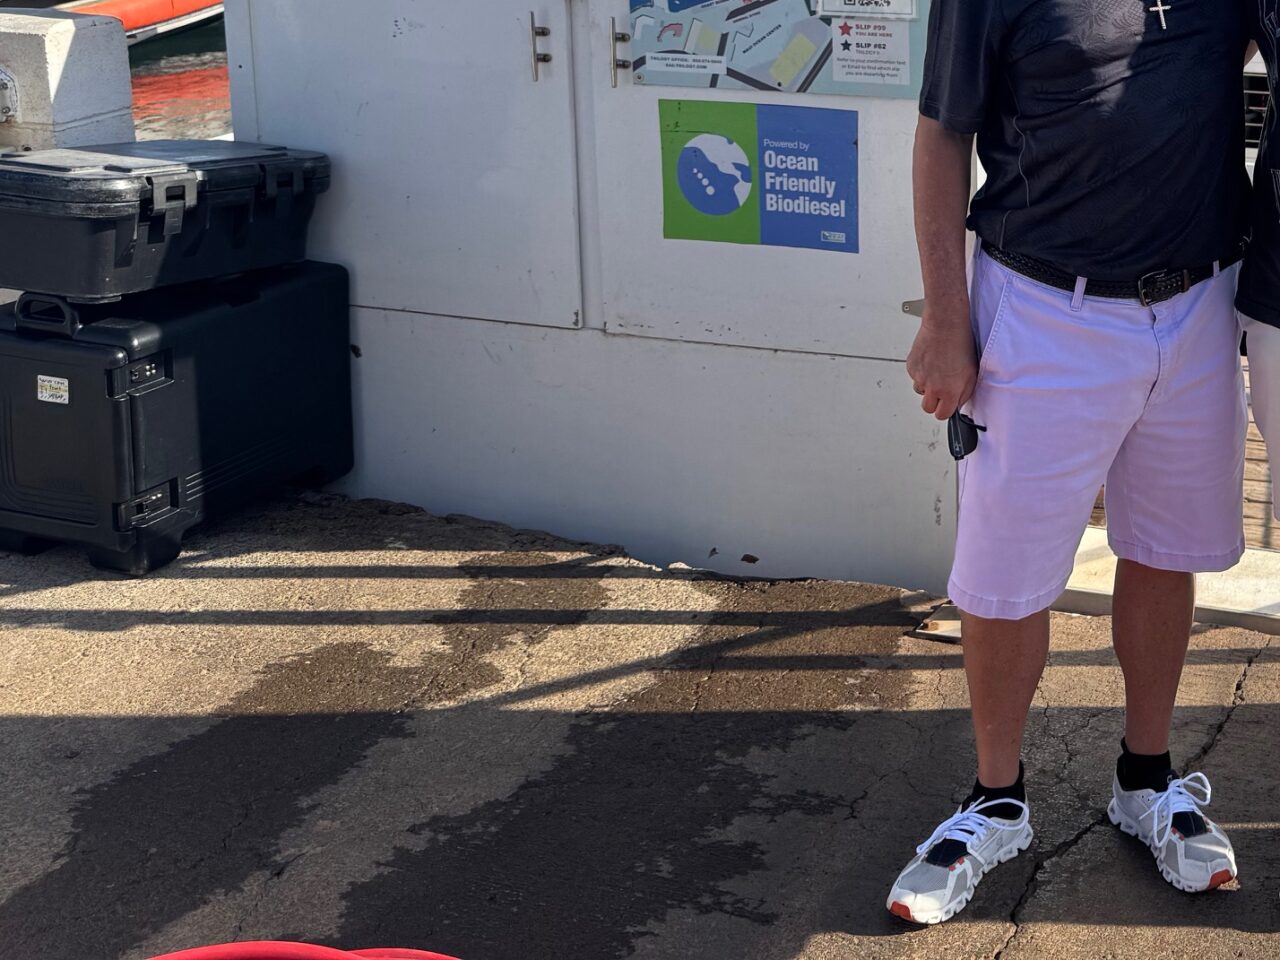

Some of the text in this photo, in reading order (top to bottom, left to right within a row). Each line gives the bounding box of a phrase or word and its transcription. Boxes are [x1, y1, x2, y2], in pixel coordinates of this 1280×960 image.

[766, 24, 781, 37] CENTER
[764, 139, 810, 152] Powered by
[764, 150, 818, 171] Ocean
[765, 172, 836, 198] Friendly
[766, 193, 845, 217] Biodiesel
